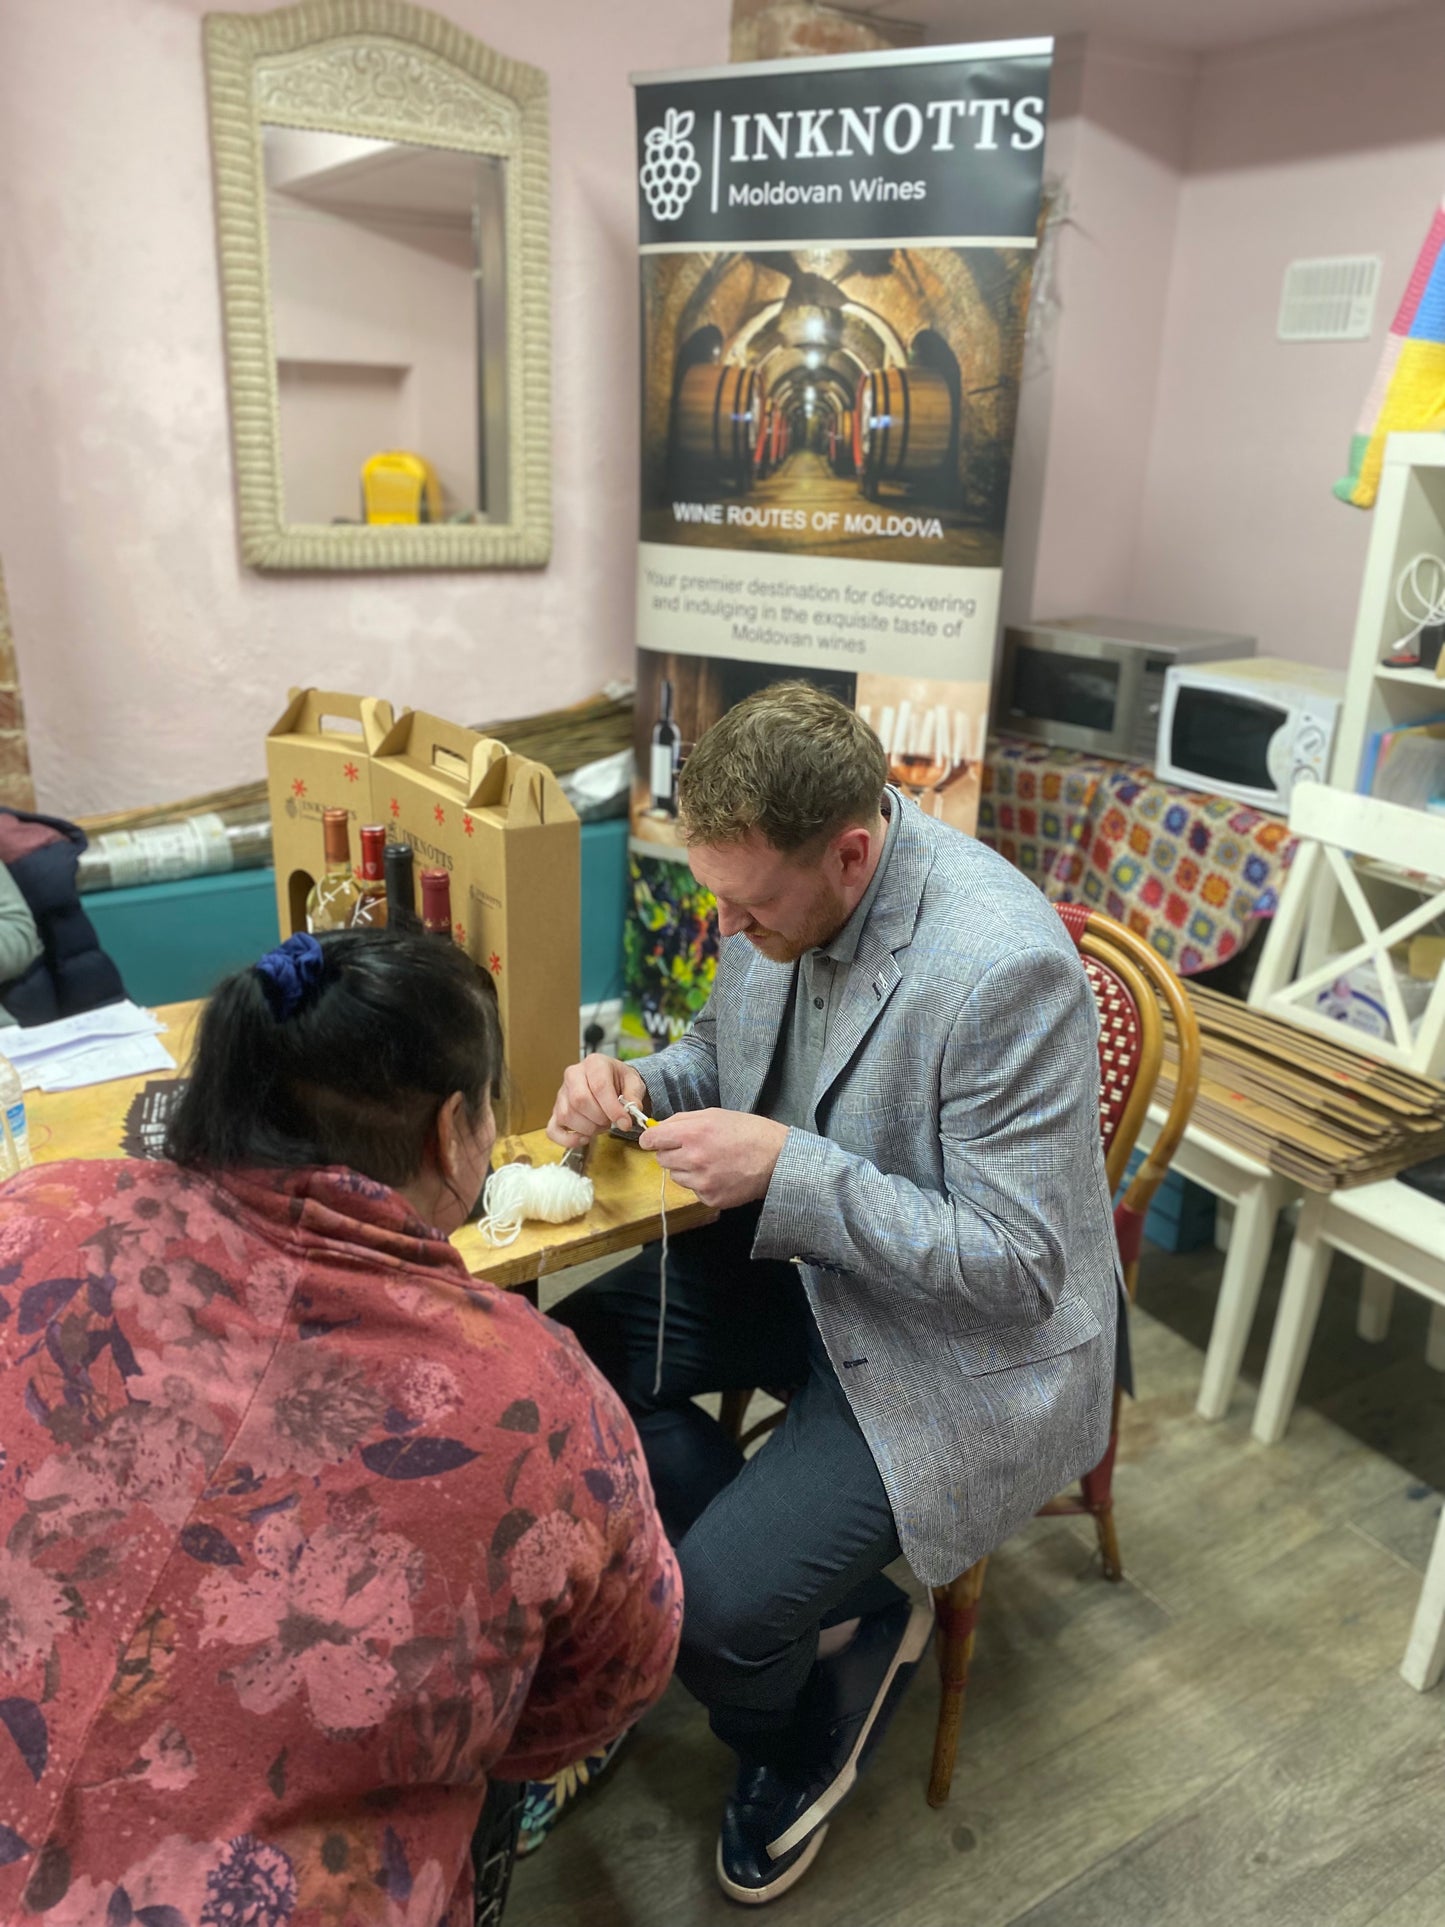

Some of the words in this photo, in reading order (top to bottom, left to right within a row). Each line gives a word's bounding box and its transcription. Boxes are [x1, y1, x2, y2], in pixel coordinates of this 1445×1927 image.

[730, 96, 1045, 162] INKNOTTS
[728, 180, 843, 207] Moldovan
[849, 177, 927, 202] Wines
[672, 501, 724, 525] WINE
[726, 504, 807, 530] ROUTES
[811, 511, 840, 532] OF
[843, 512, 945, 539] MOLDOVA
[647, 570, 677, 588] Your
[679, 574, 744, 593] premier
[747, 577, 841, 602] destination
[845, 585, 868, 604] for
[871, 588, 977, 618] discovering
[652, 596, 680, 612] and
[683, 597, 759, 622] indulging
[761, 603, 777, 620] in
[780, 605, 809, 623] the
[812, 609, 890, 633] exquisite
[893, 614, 938, 637] taste
[942, 619, 965, 638] of
[731, 623, 813, 647] Moldovan
[816, 633, 868, 654] wines
[403, 829, 454, 872] INKNOTTS
